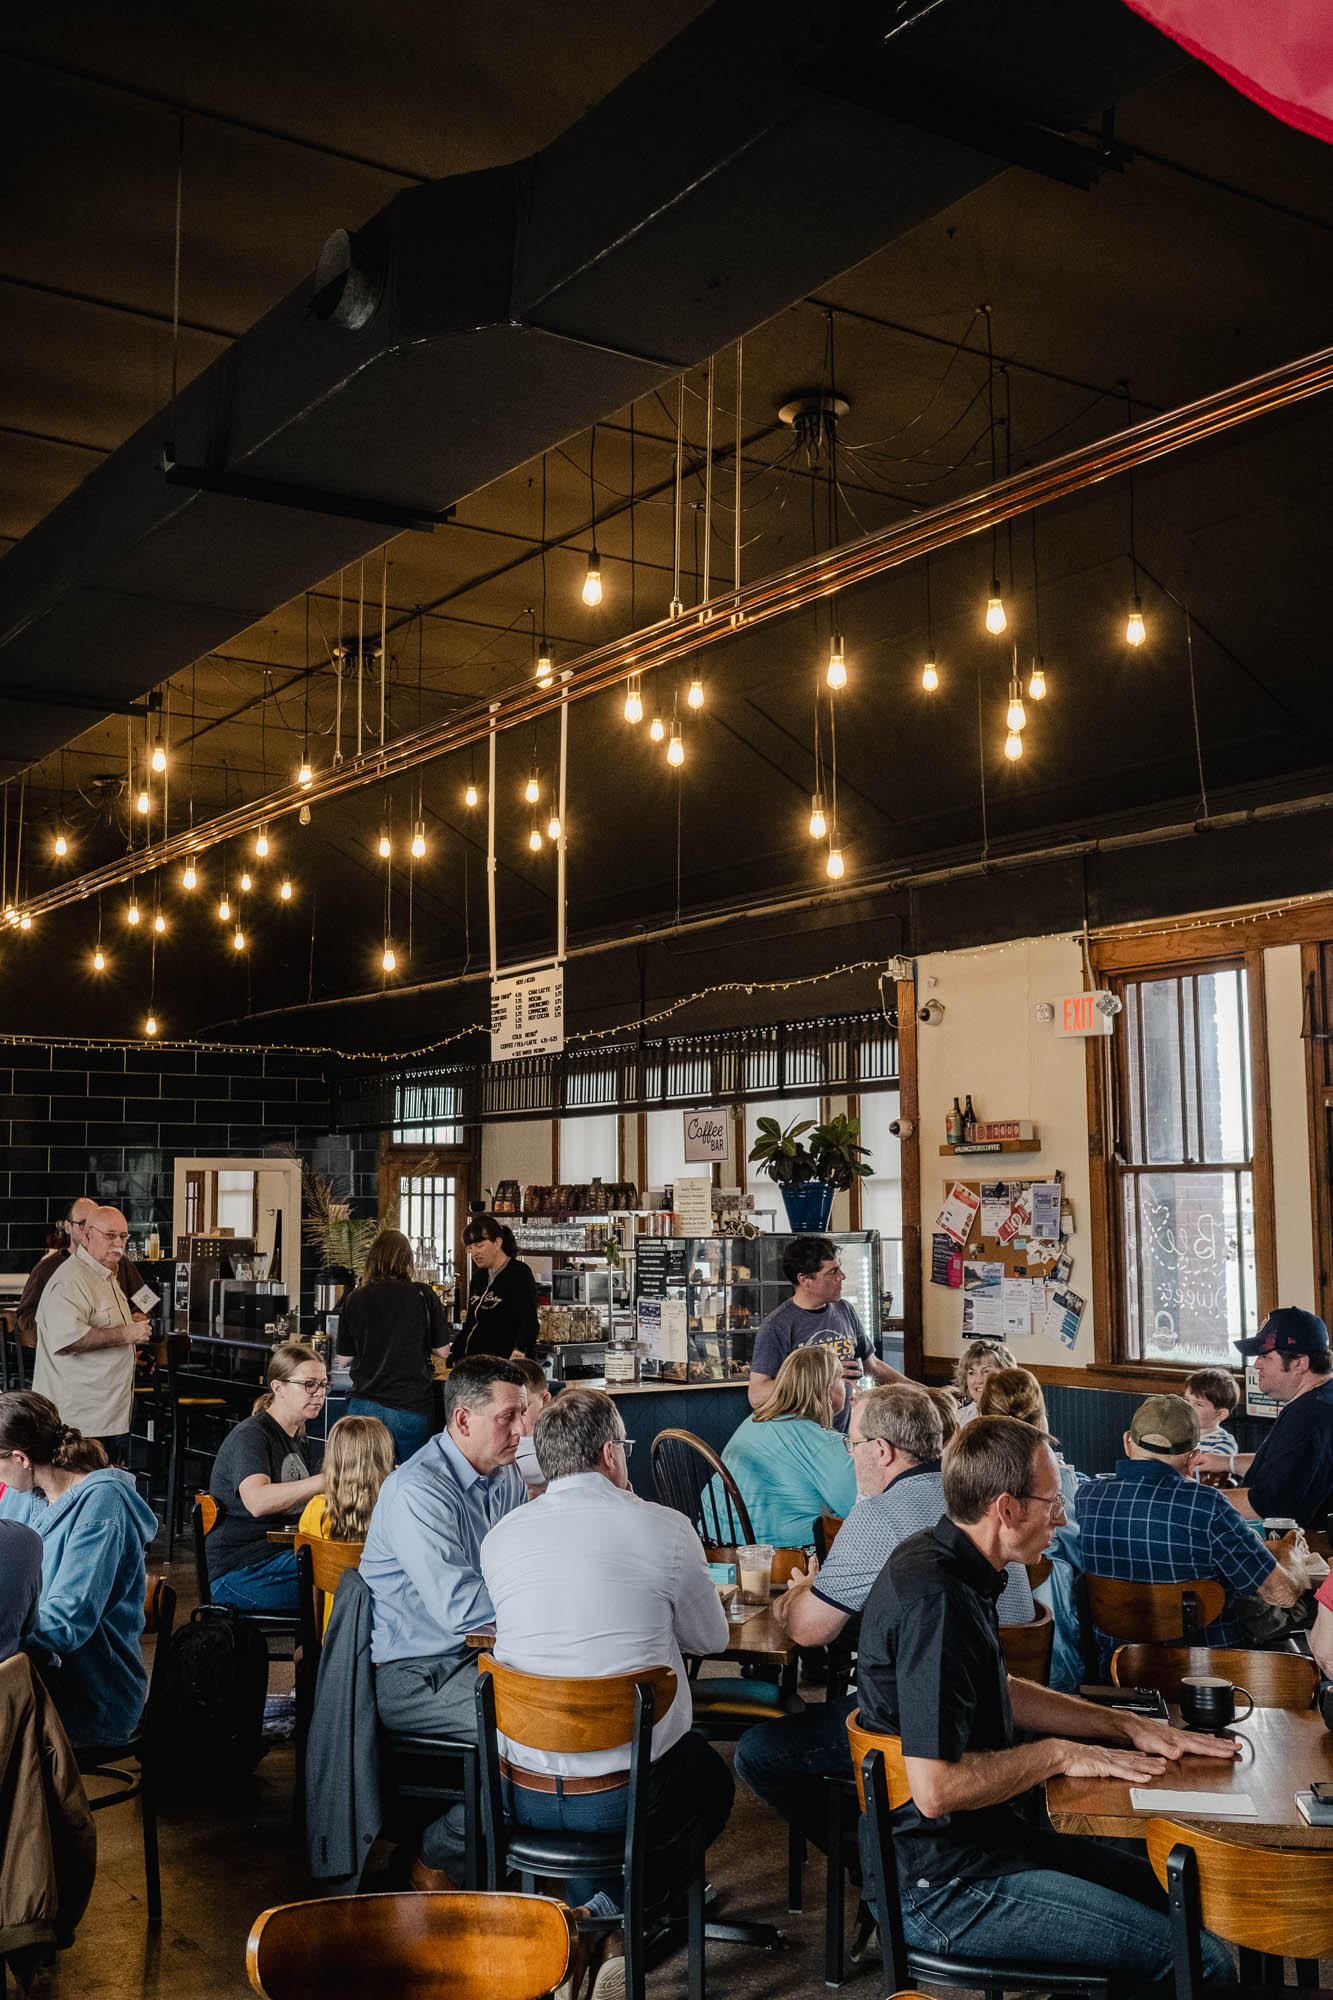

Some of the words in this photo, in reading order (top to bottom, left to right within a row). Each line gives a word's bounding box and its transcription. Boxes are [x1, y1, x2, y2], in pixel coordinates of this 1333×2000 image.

[1064, 996, 1095, 1031] EXIT
[688, 1117, 724, 1144] Coffee
[711, 1138, 724, 1151] BAR
